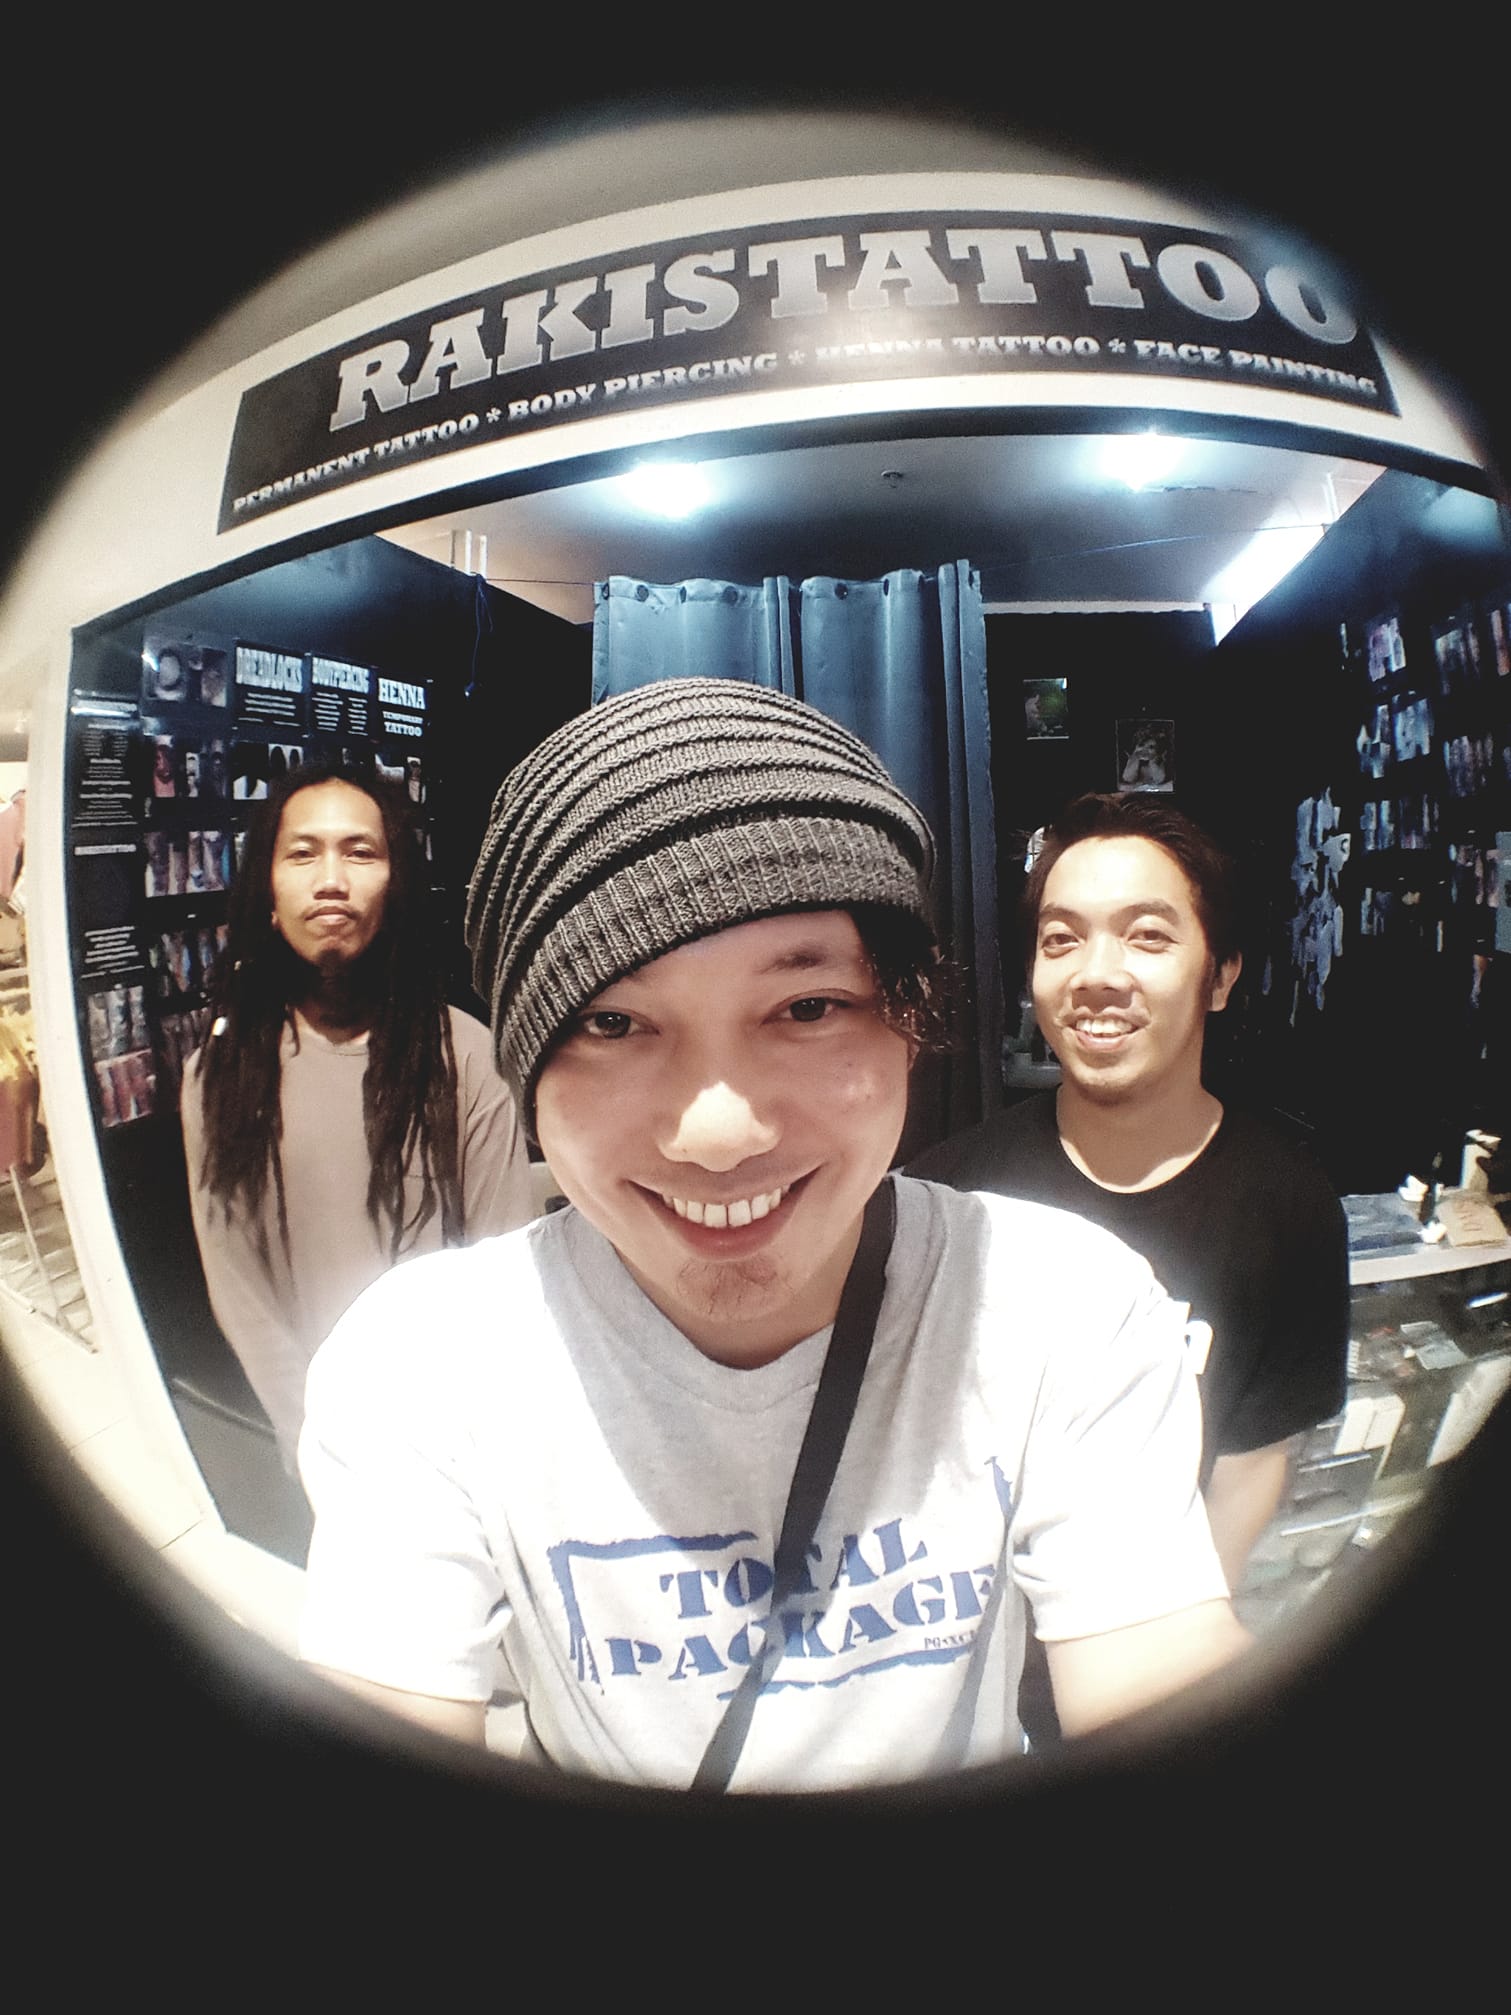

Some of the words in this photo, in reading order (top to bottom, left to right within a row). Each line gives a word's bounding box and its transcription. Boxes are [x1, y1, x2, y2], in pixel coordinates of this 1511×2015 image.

[328, 228, 1358, 434] RAKISTATTOO
[232, 447, 371, 512] PERMANENT
[373, 413, 480, 461] TATTOO
[507, 383, 597, 421] BODY
[603, 352, 778, 398] PIERCING
[814, 337, 944, 362] HENNA
[952, 335, 1101, 358] TATTOO
[1133, 338, 1222, 366] FACE
[1227, 348, 1378, 395] PAINTING
[378, 677, 427, 711] HENNA
[384, 721, 424, 738] TATTOO
